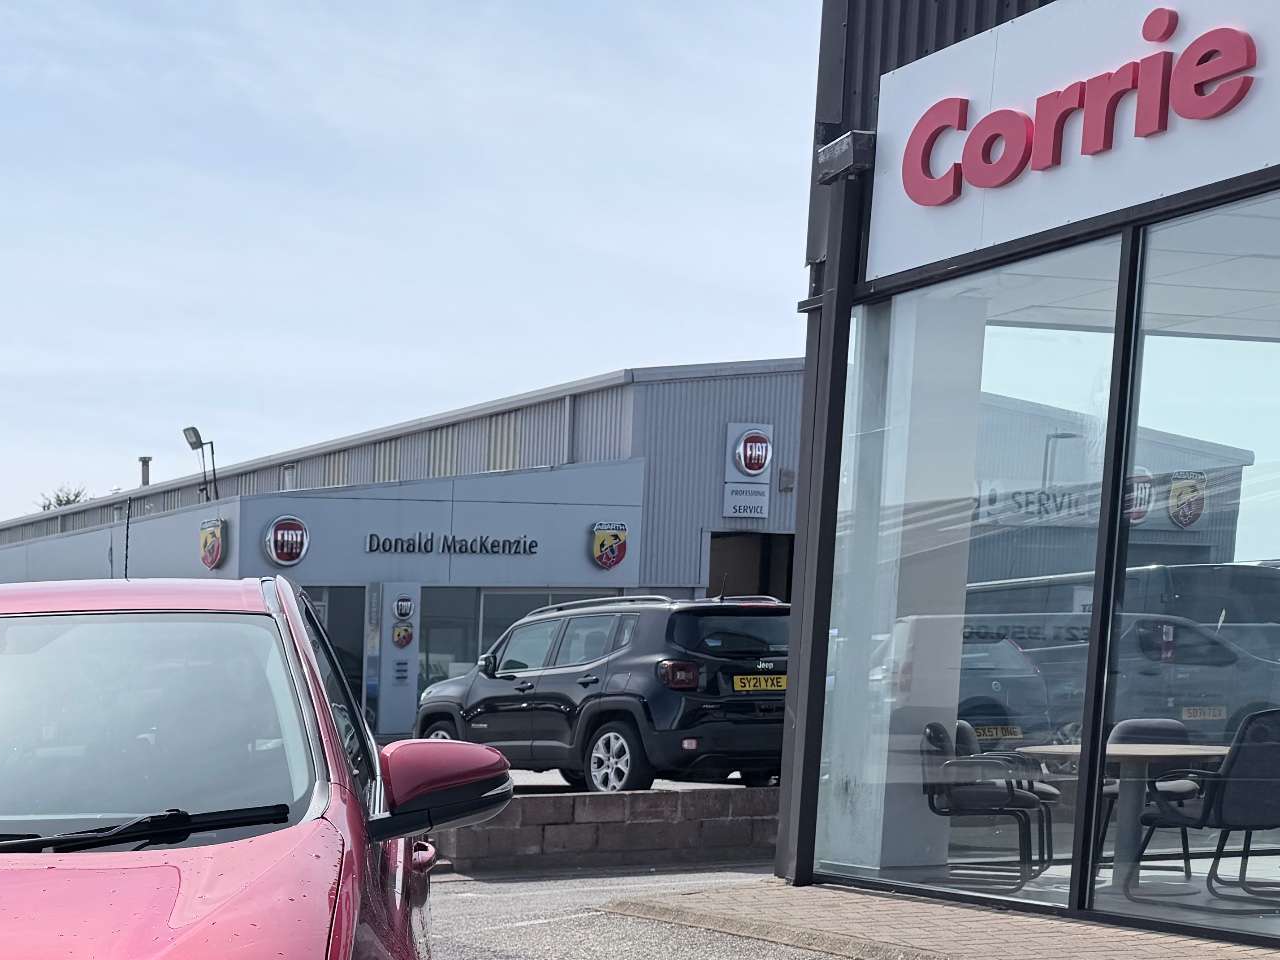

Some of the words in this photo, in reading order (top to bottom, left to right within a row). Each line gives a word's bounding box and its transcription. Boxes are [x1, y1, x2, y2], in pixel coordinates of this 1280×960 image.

[902, 7, 1257, 206] Corrie
[746, 442, 768, 463] FIAT
[732, 504, 764, 514] SERVICE
[277, 530, 302, 553] FIAT
[368, 531, 434, 553] Donald
[440, 534, 539, 555] MacKenzie
[756, 660, 774, 670] Jeep
[764, 676, 783, 688] YXE
